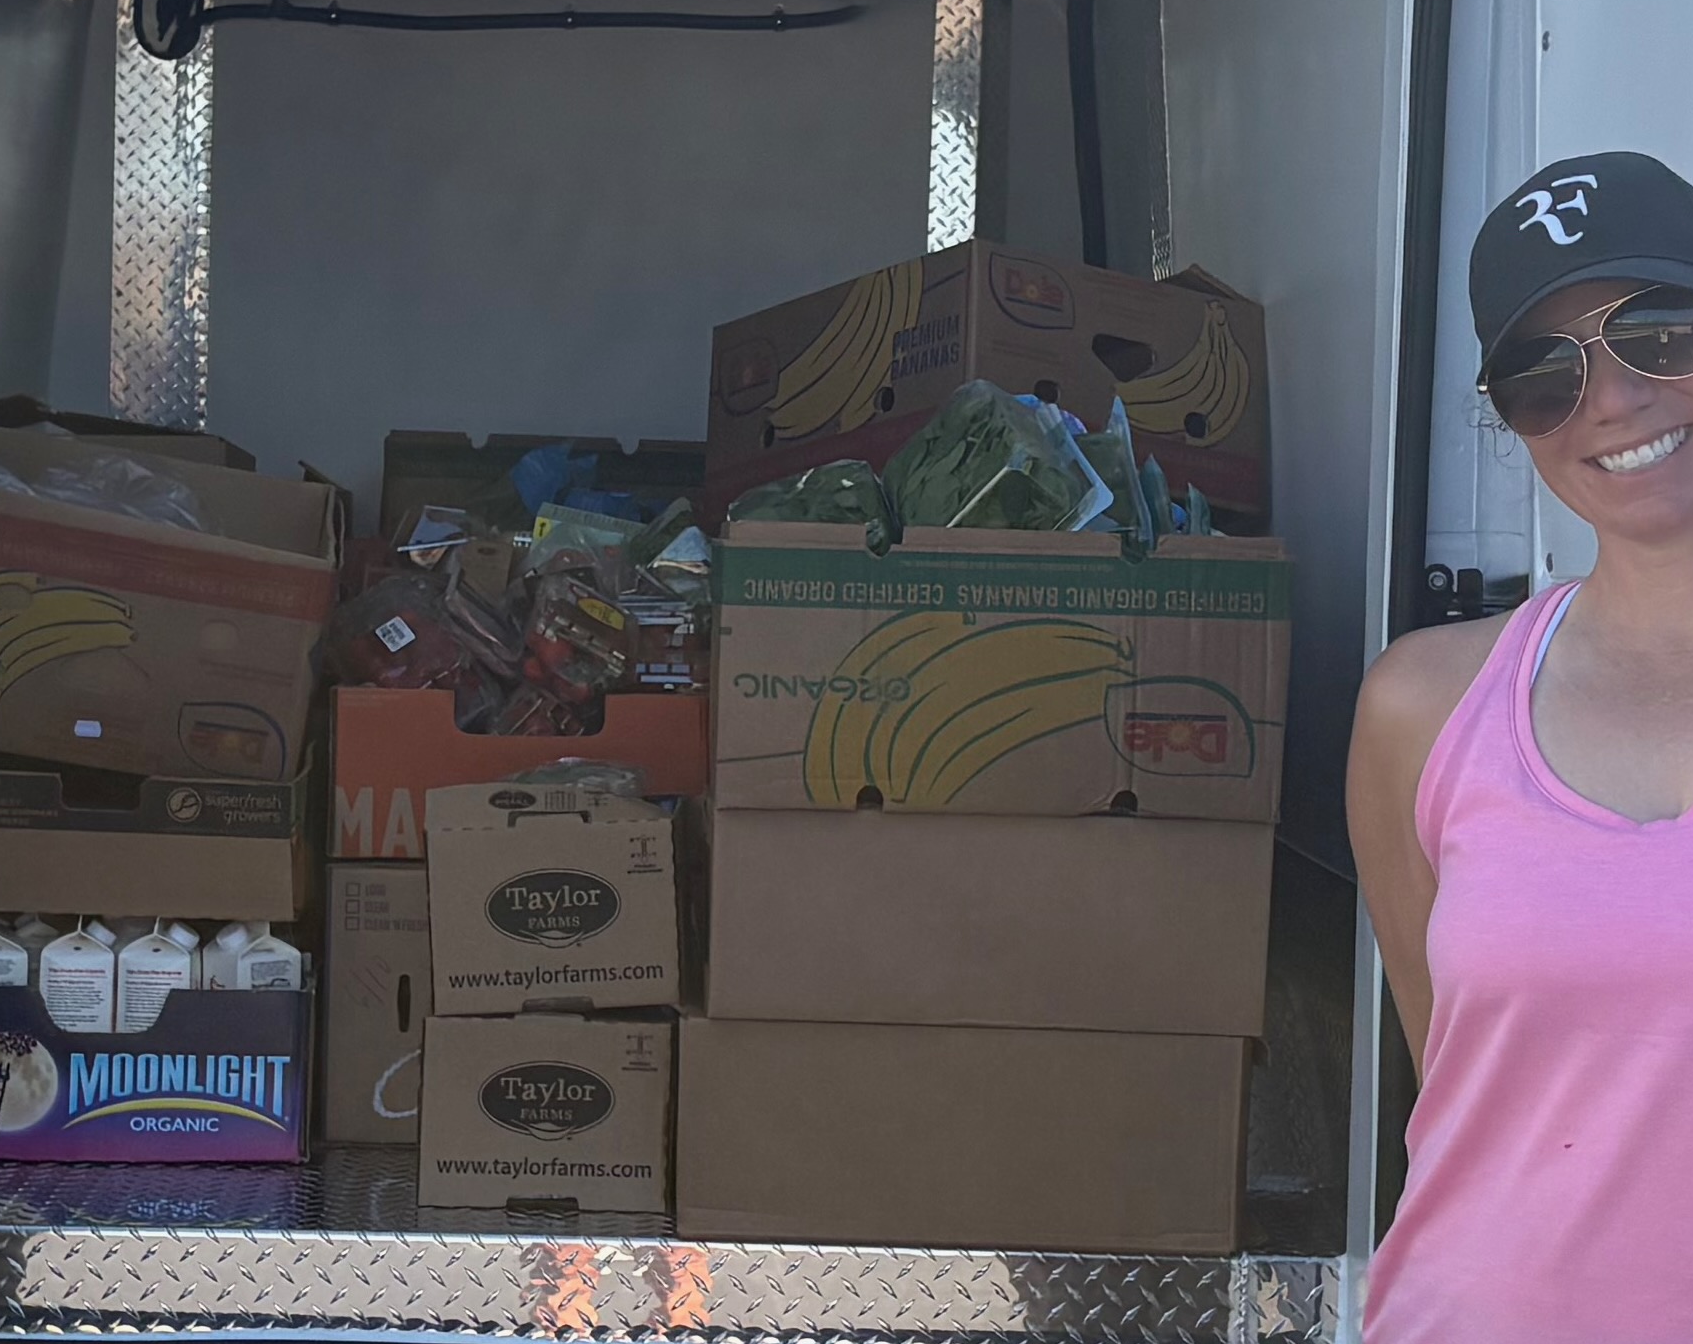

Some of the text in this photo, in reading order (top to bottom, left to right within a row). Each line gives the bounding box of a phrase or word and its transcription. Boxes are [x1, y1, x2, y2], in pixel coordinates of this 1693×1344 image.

[894, 314, 960, 351] PREMIUM
[892, 343, 960, 380] BANANAS
[744, 579, 1264, 613] CERTIFIED ORGANIC BANANAS CERTIFIED ORGANIC
[732, 671, 912, 702] ORGANIC
[1124, 721, 1227, 763] Dole
[224, 809, 281, 825] growers
[505, 884, 601, 915] Taylor
[527, 915, 581, 930] FARMS
[448, 963, 664, 990] www.taylorfarms.com
[68, 1052, 291, 1118] MOONLIGHT
[500, 1077, 596, 1107] Taylor
[129, 1116, 219, 1132] ORGANIC
[519, 1107, 574, 1122] FARMS
[436, 1156, 652, 1180] www.taylorfarms.com
